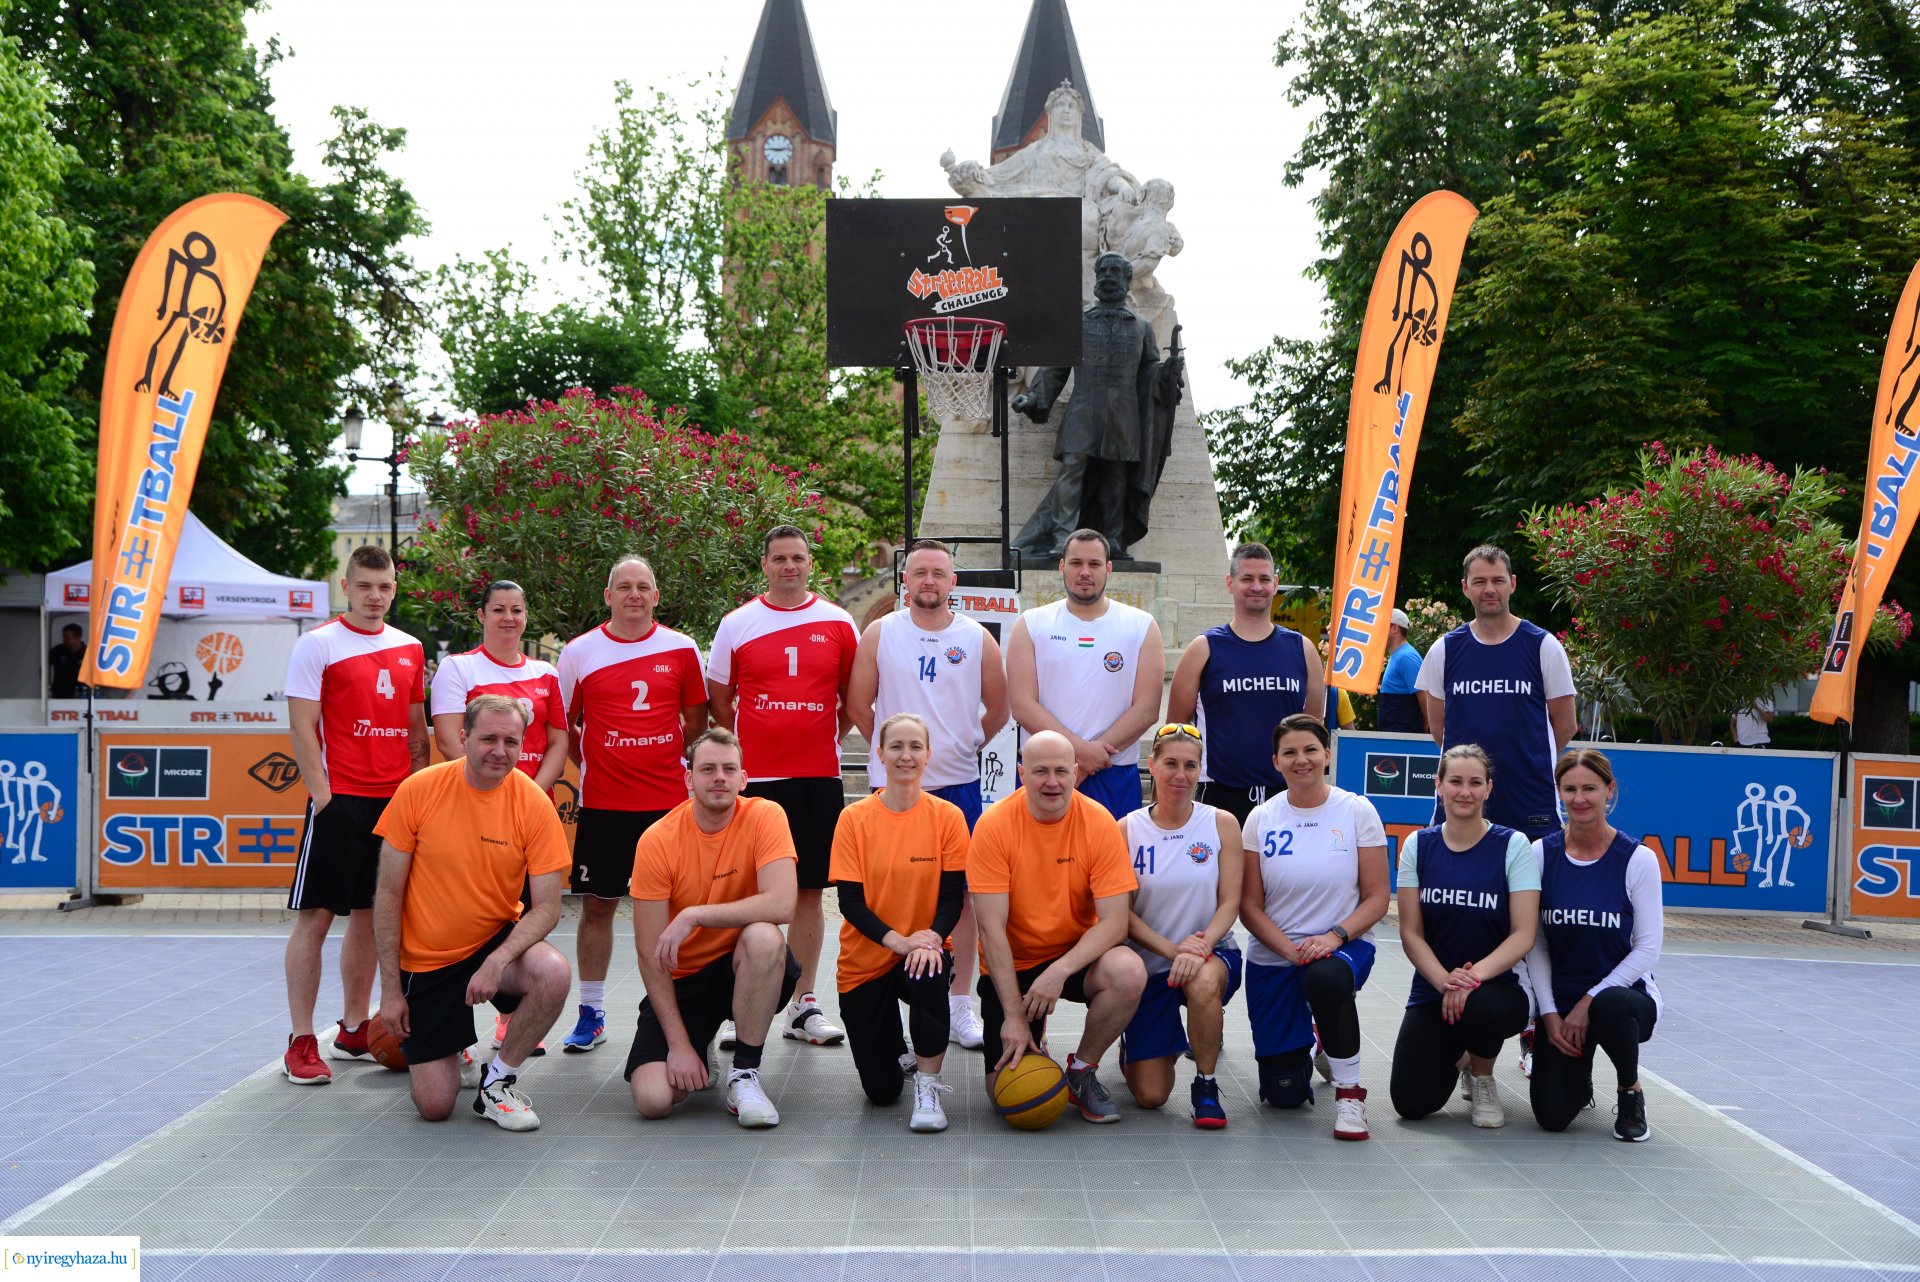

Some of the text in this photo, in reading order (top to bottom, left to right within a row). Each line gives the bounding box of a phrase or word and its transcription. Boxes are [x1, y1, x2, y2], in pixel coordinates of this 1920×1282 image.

[941, 287, 1004, 311] CHALLENGE
[215, 595, 277, 605] VERSENYIRODA
[1049, 634, 1067, 642] JAKO
[784, 646, 798, 676] 1
[917, 655, 937, 683] 14
[376, 668, 396, 700] 4
[1222, 676, 1300, 693] MICHELIN
[1453, 679, 1531, 696] MICHELIN
[631, 680, 650, 711] 2
[768, 698, 824, 712] marso
[619, 733, 674, 747] marso
[164, 768, 203, 776] MKOSZ
[1263, 829, 1294, 858] 52
[1133, 845, 1155, 875] 41
[580, 864, 590, 882] 2
[1420, 887, 1498, 910] MICHELIN
